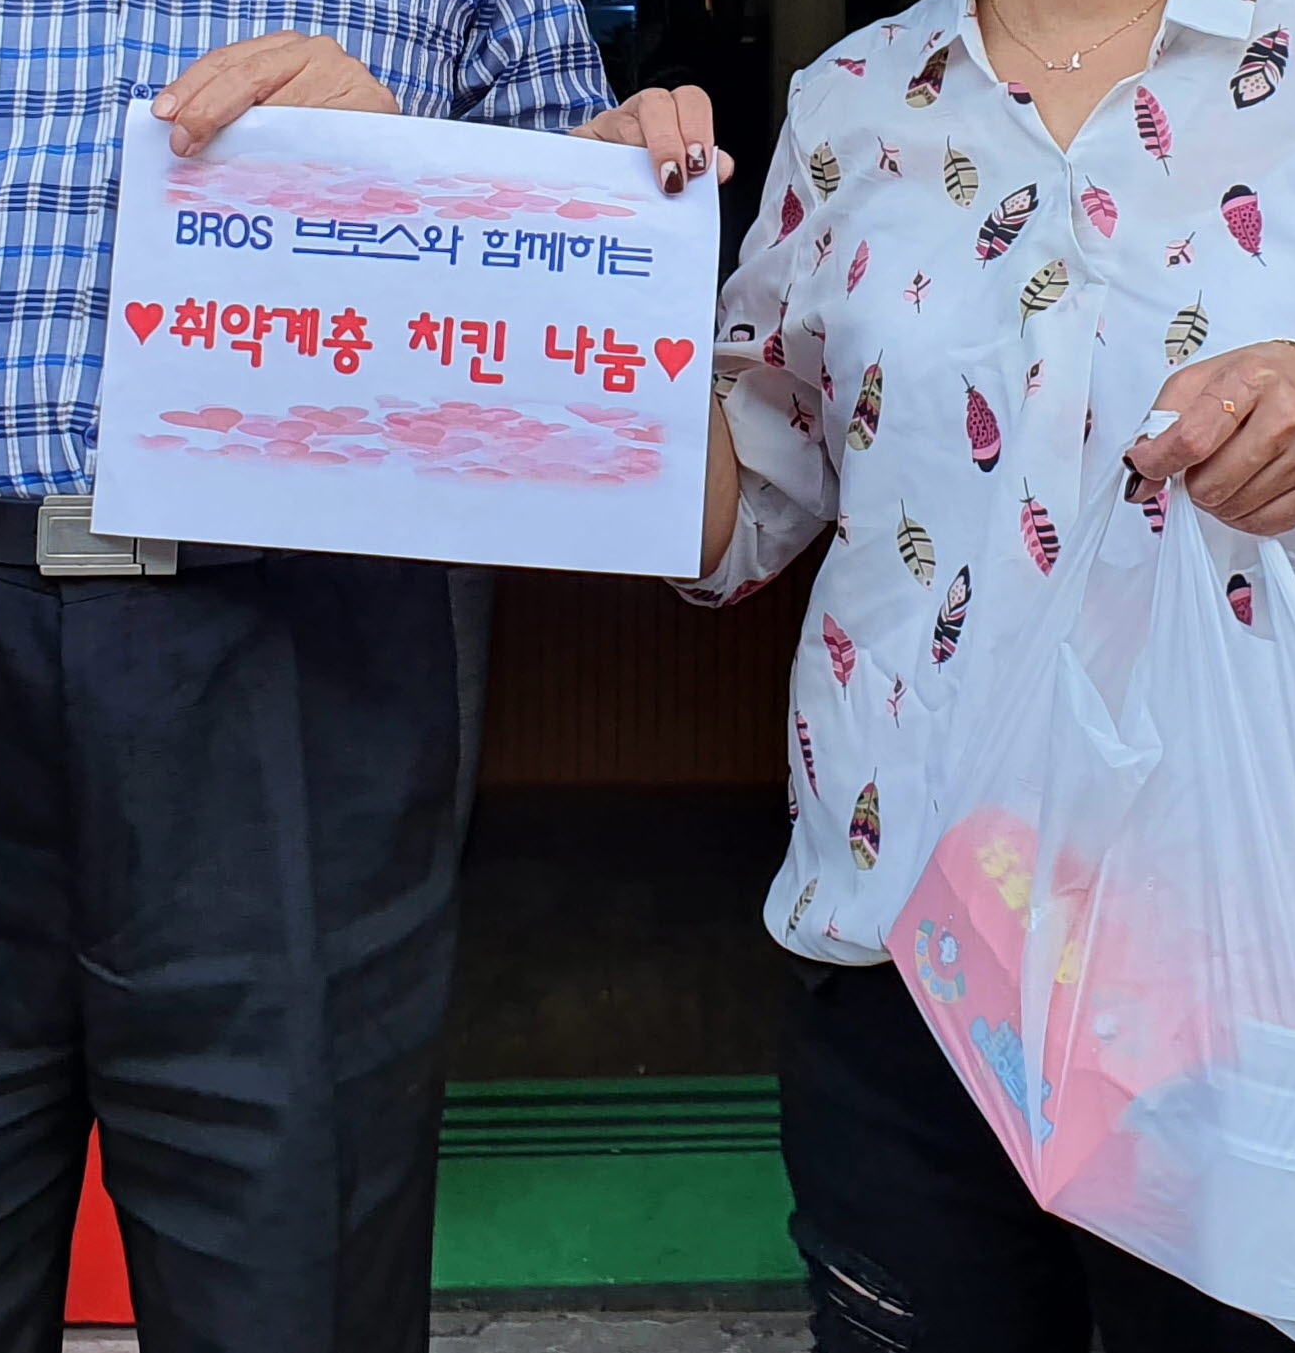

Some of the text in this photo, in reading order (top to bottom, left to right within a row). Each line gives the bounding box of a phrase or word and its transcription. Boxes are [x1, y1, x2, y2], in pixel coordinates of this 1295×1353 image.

[175, 210, 654, 277] BROS 브로스와 함께하는
[169, 297, 646, 393] 취약계층 치킨 나눔
